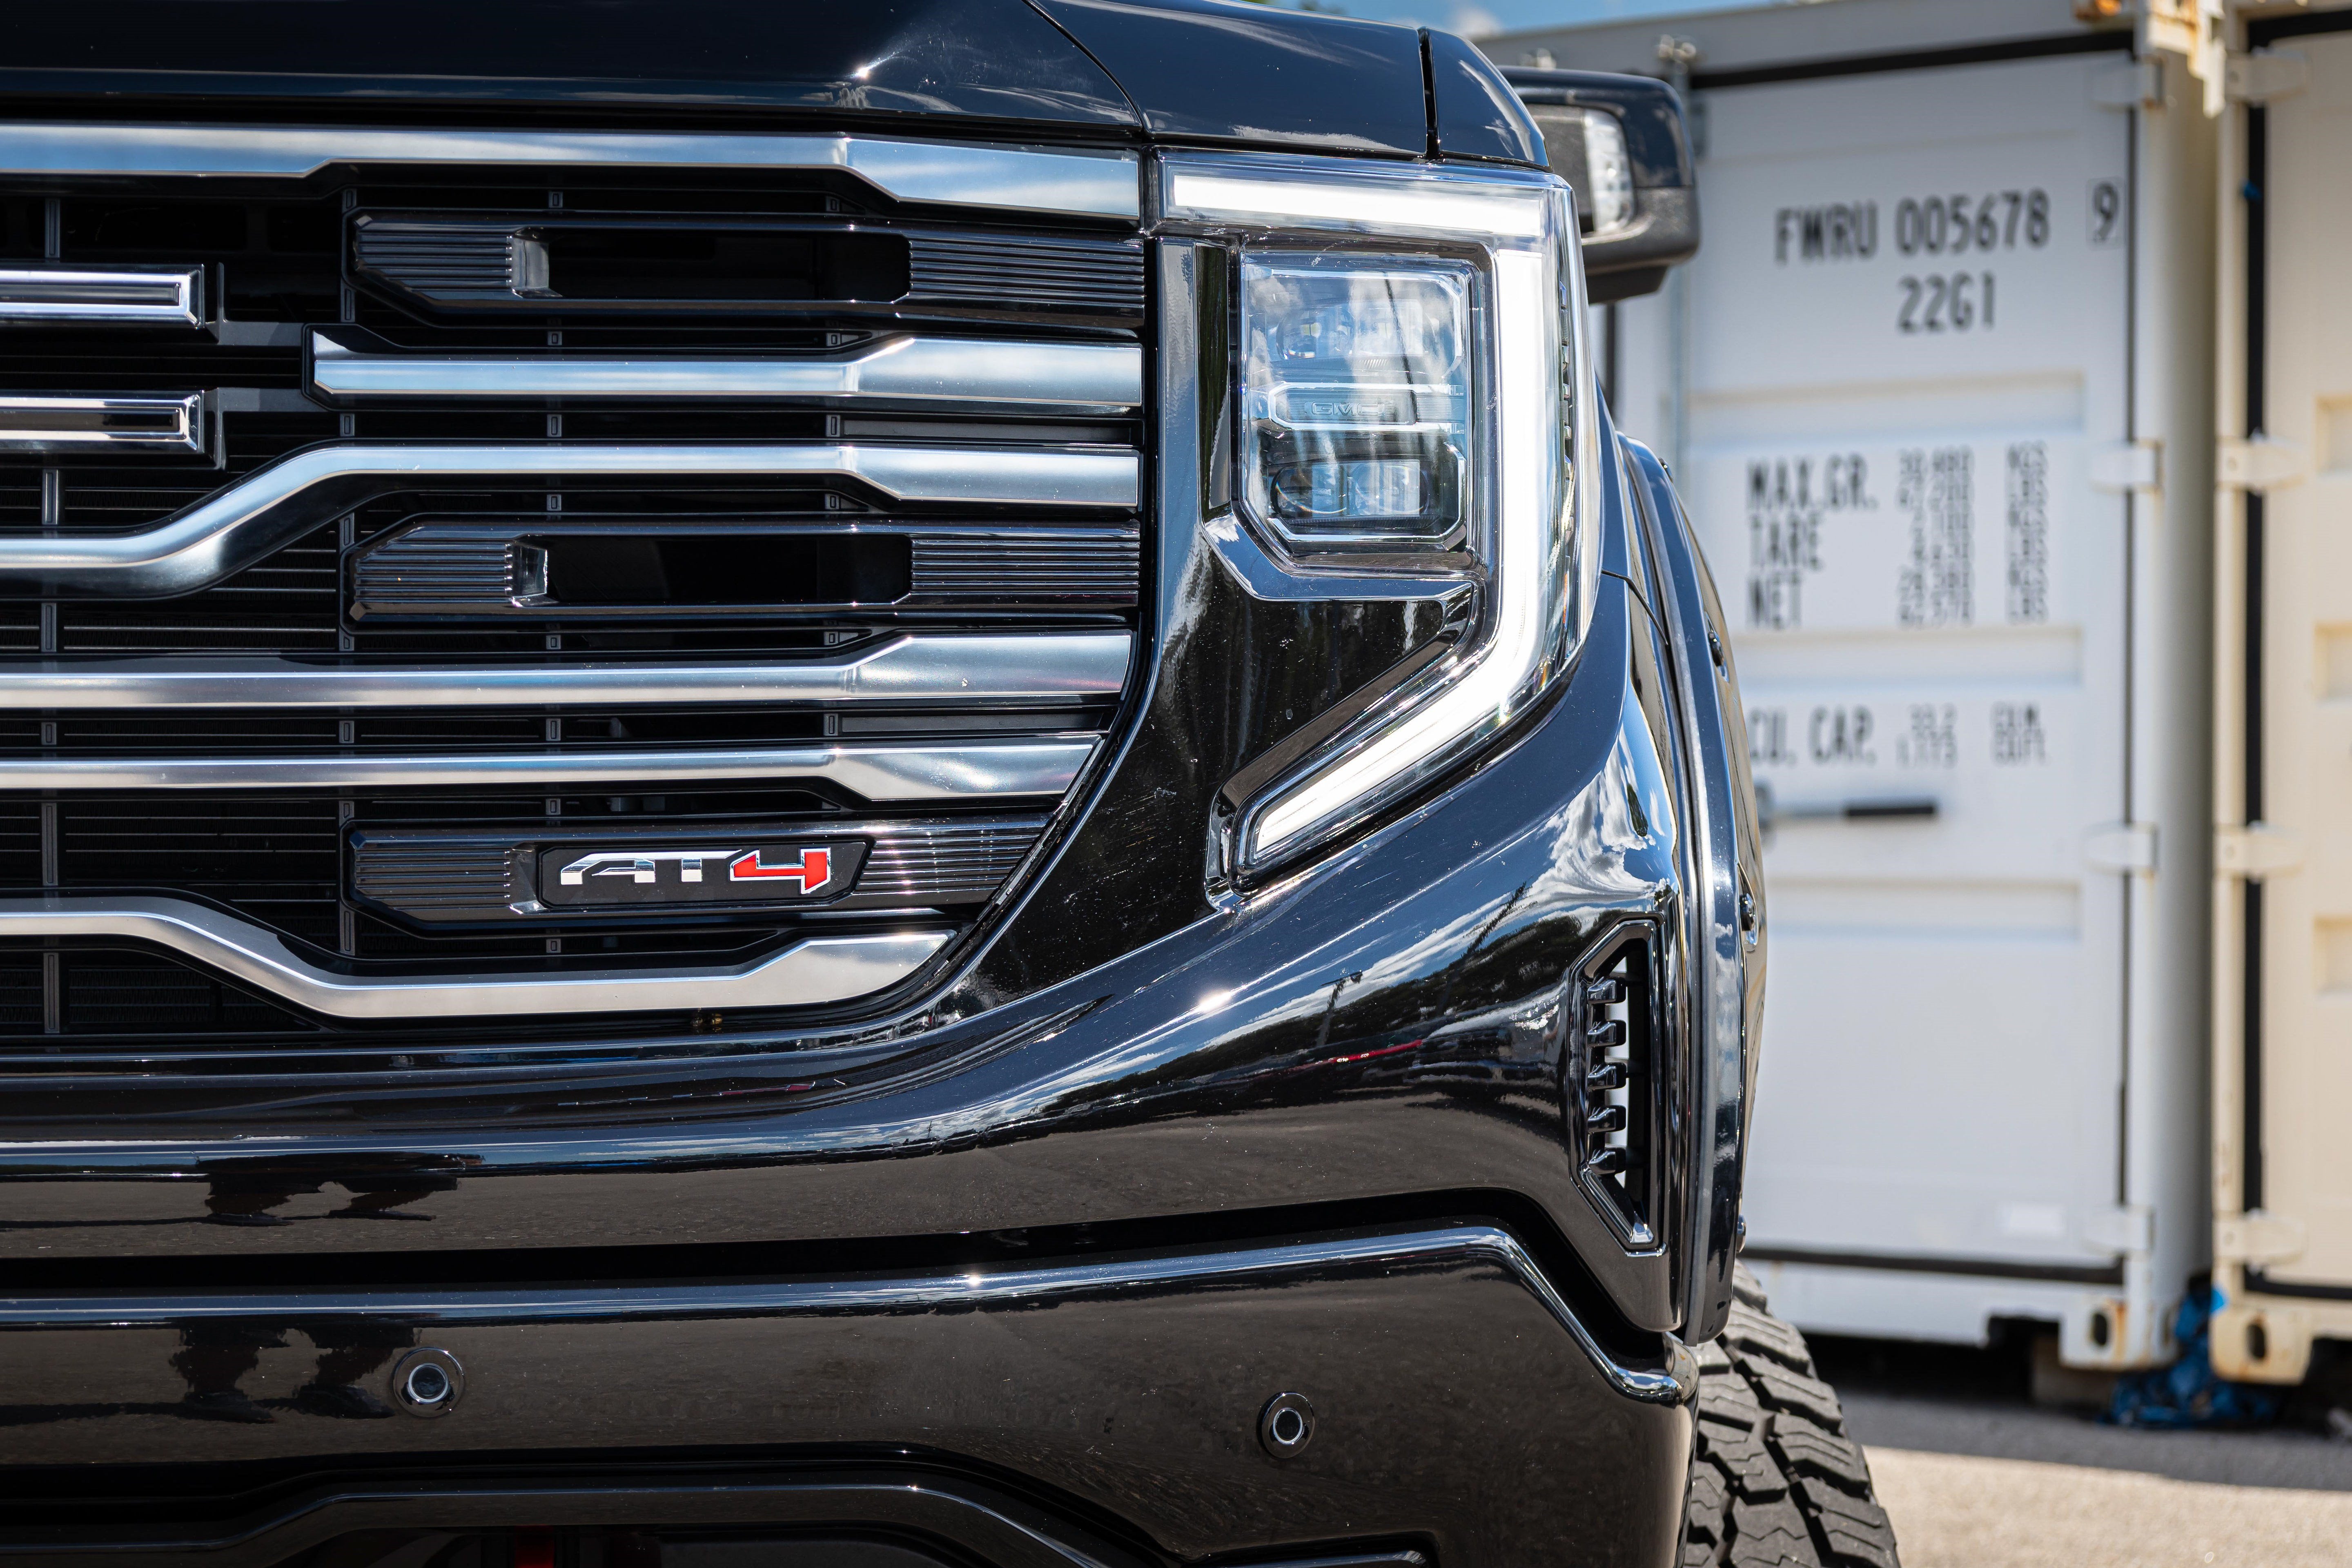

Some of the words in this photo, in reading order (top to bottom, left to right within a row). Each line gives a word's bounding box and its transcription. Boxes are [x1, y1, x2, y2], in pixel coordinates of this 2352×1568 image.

[1775, 200, 1878, 266] FWRU
[1894, 188, 2051, 257] 005678
[2092, 183, 2120, 244] 9
[1896, 271, 1996, 334] 22G1
[1311, 401, 1381, 416] GMC
[1748, 514, 1824, 572] TARE
[1748, 572, 1804, 629] NET
[1811, 707, 1877, 765] CAP.
[560, 847, 831, 895] AT4
